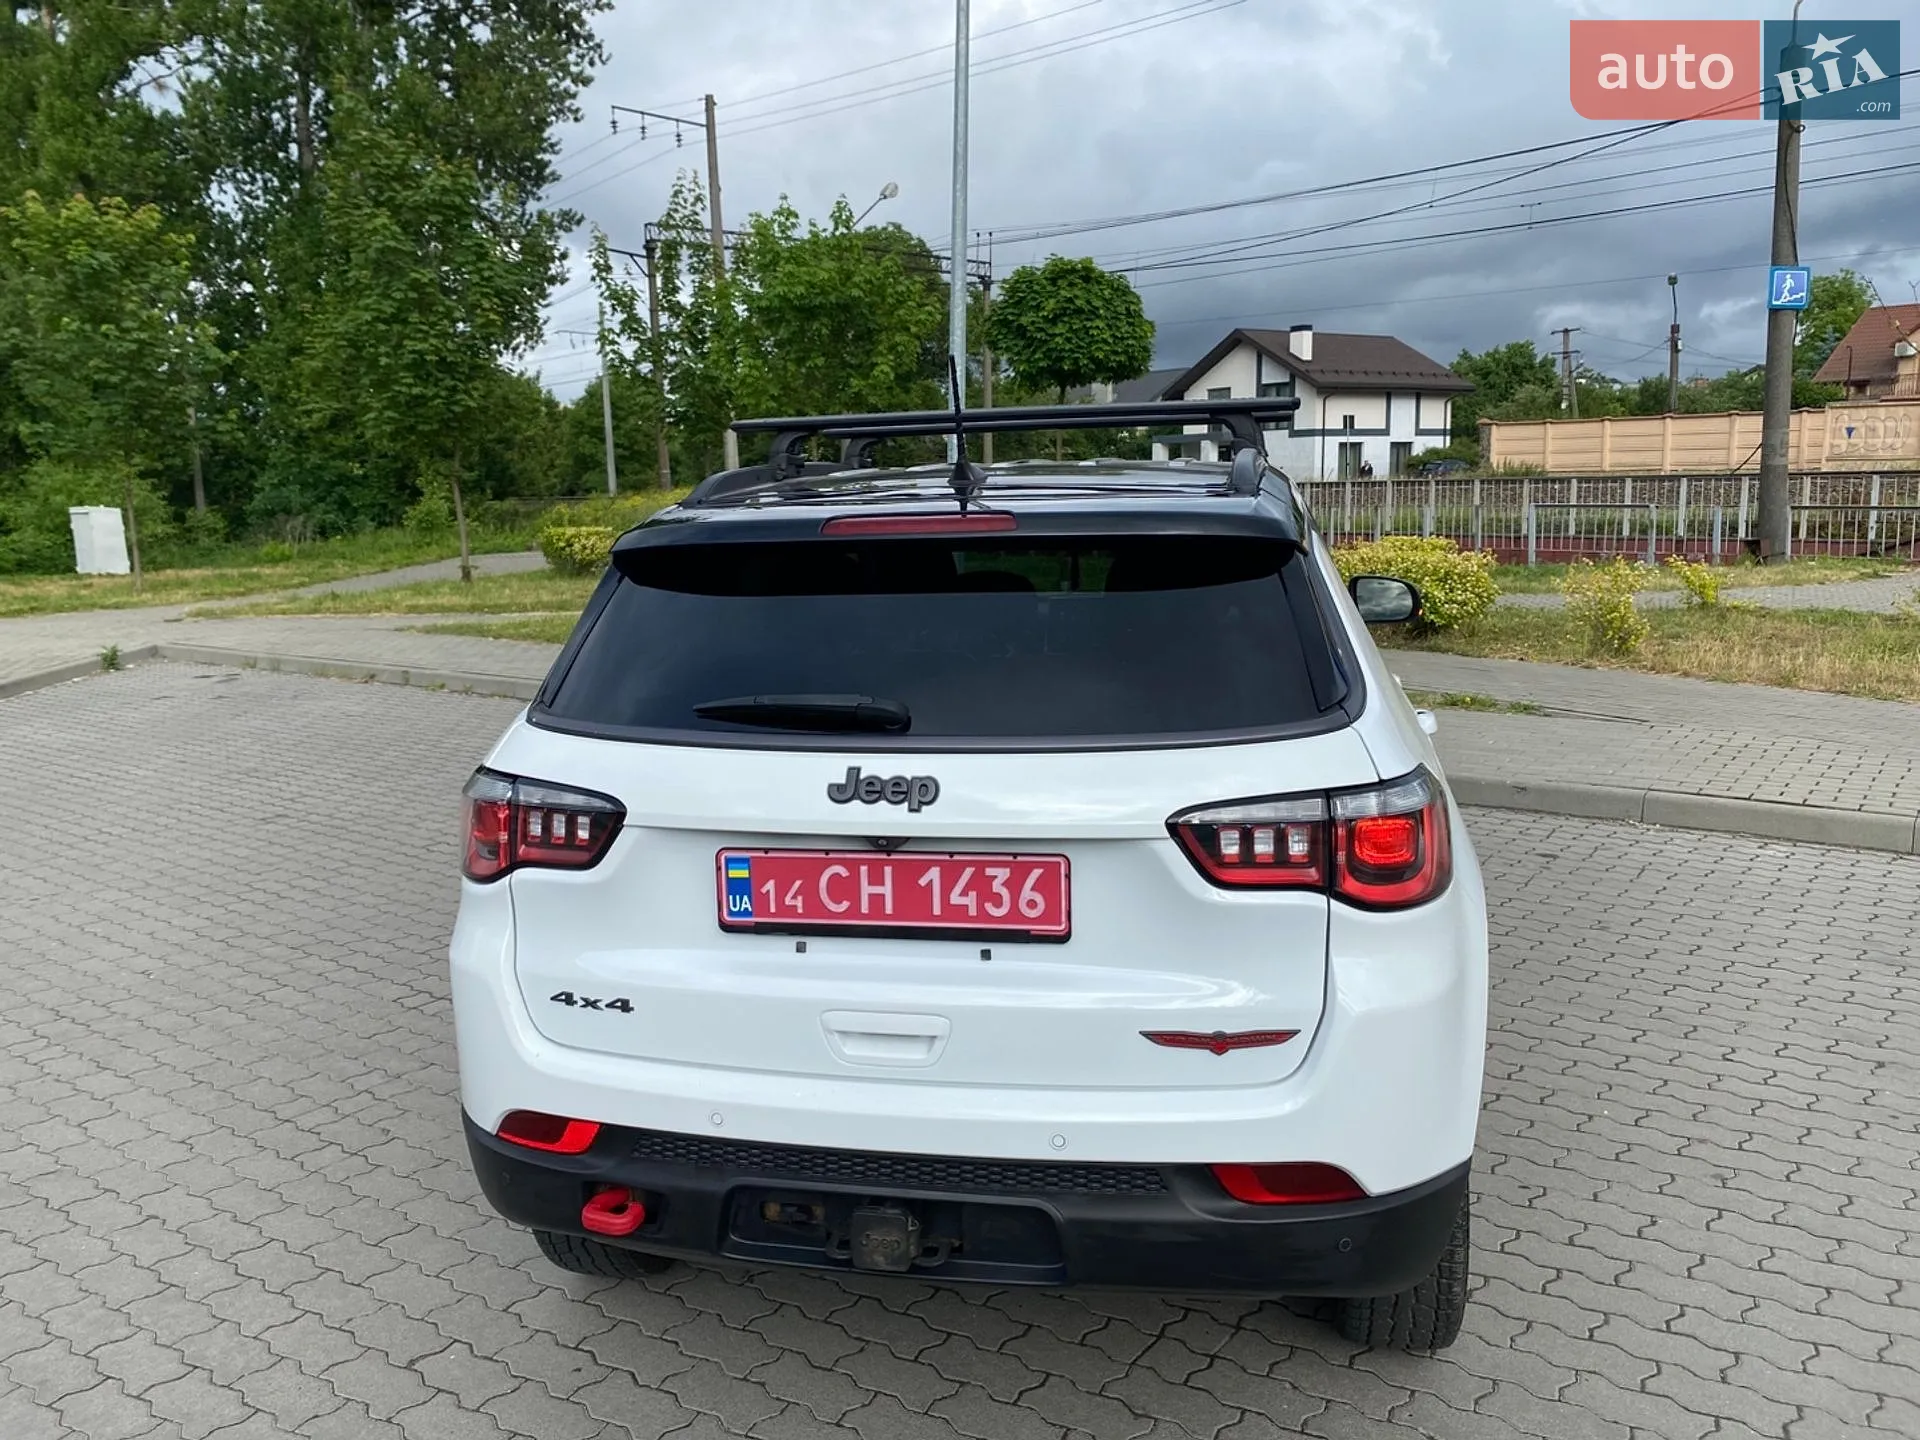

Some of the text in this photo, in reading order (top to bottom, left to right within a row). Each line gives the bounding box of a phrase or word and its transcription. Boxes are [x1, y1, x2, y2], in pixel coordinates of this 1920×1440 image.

[827, 766, 940, 813] Jeep
[729, 895, 752, 912] UA
[760, 865, 1046, 919] 14 CH 1436
[550, 991, 634, 1013] 4x4
